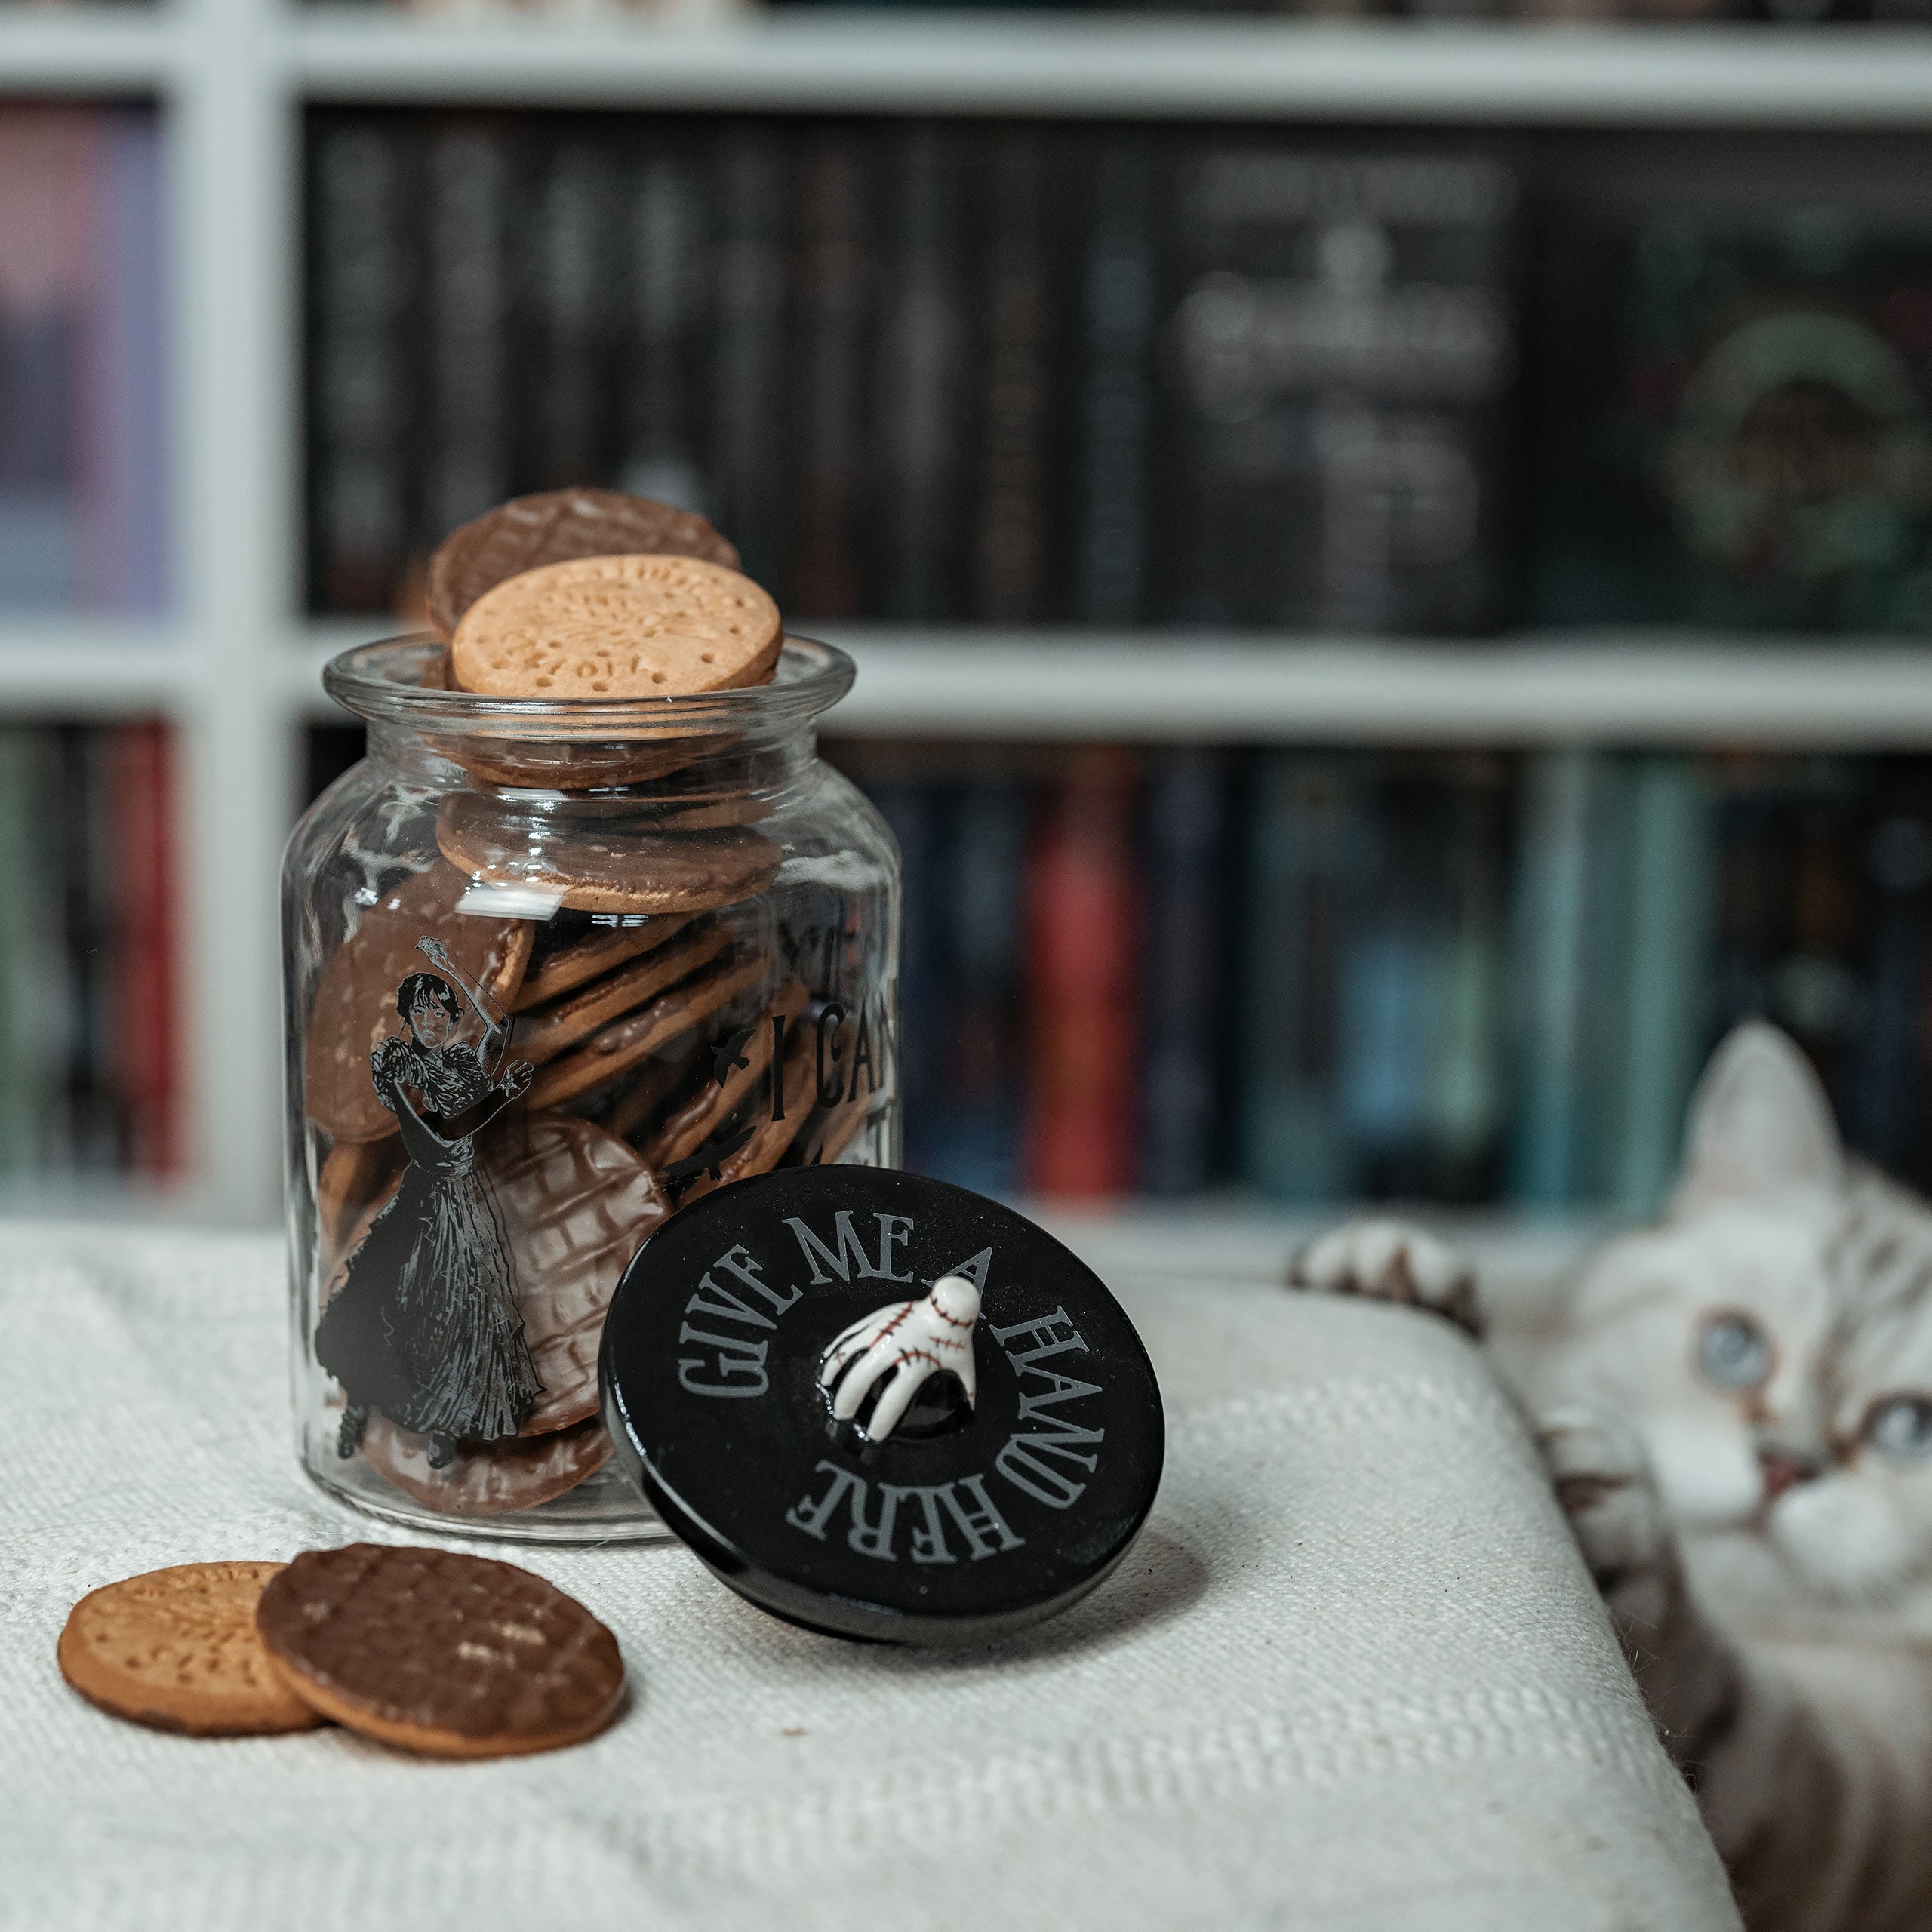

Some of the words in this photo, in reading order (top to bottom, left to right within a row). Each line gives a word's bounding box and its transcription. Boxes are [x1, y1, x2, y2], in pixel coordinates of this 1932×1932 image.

[771, 1014, 786, 1122] I
[782, 1210, 914, 1285] ME
[921, 1247, 992, 1320] A
[678, 1244, 804, 1399] GIVE
[989, 1305, 1105, 1509] HAND
[785, 1459, 1026, 1564] HERE
